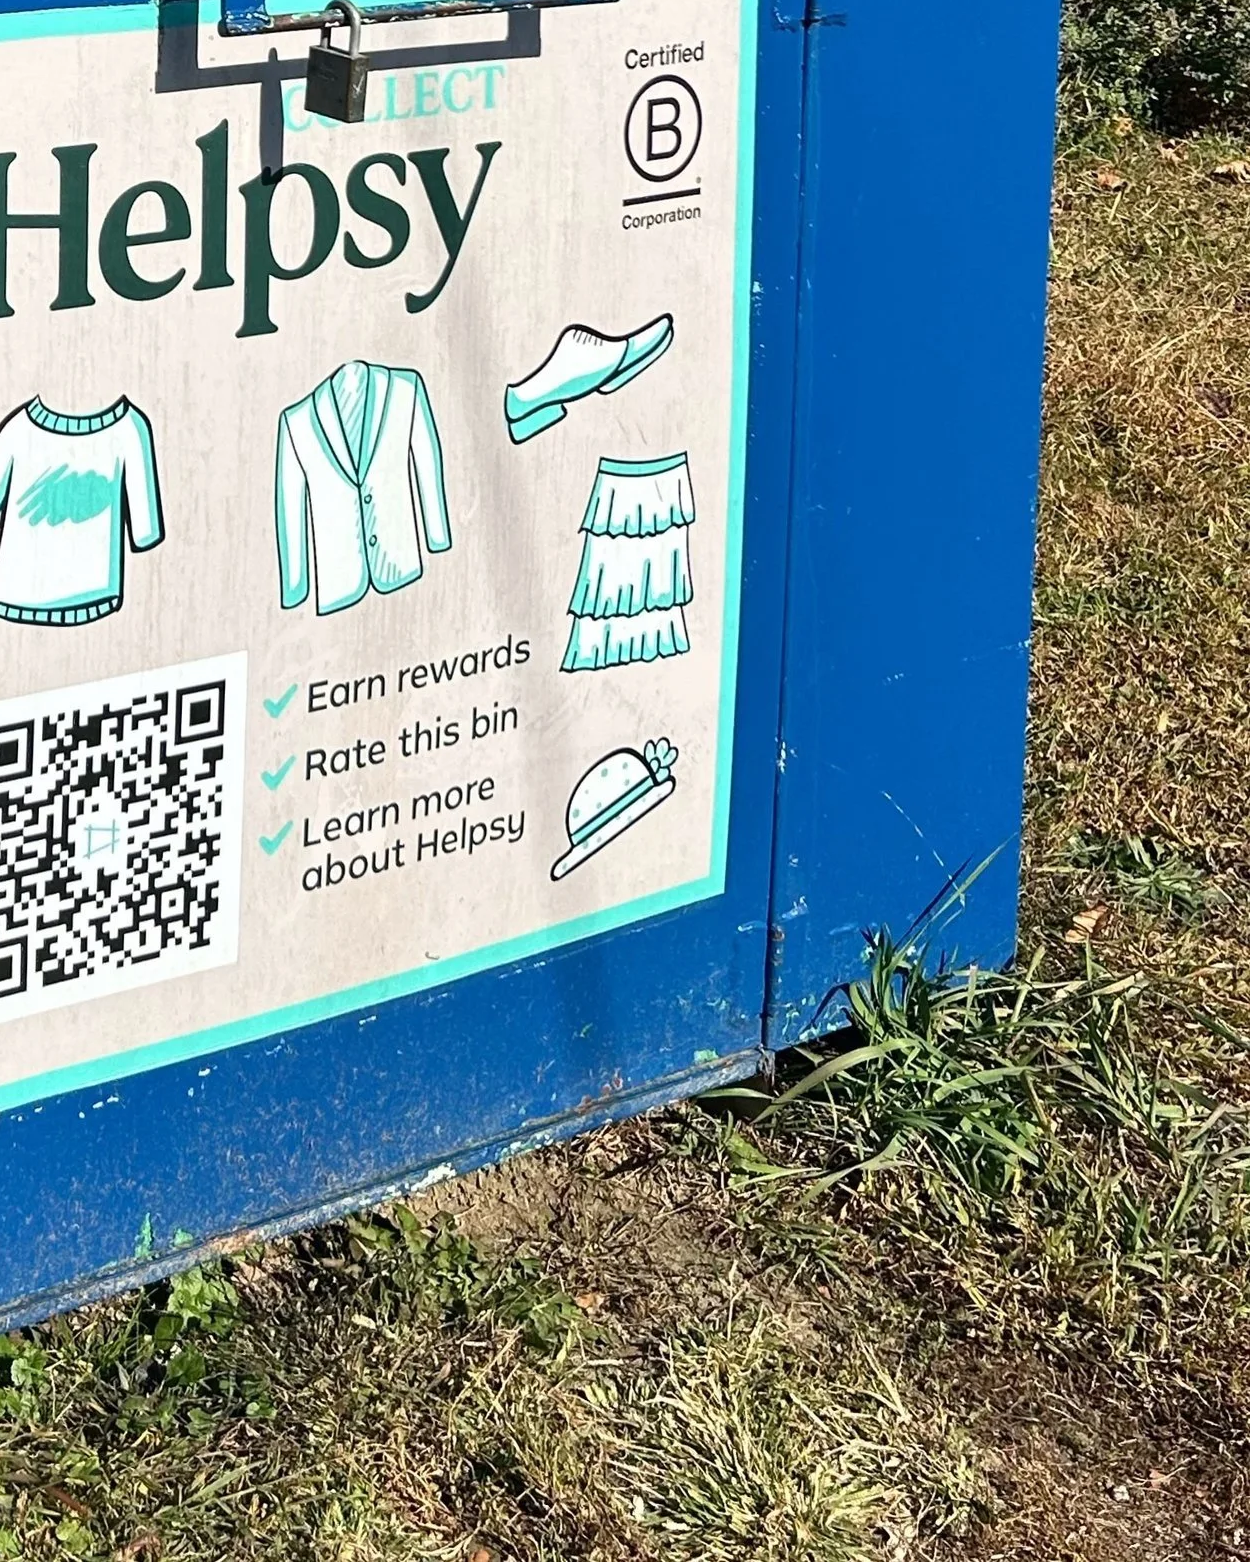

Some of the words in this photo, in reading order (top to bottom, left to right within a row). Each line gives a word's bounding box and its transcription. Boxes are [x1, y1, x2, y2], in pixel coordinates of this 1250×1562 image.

[624, 40, 706, 70] Certified
[621, 205, 702, 231] Corporation
[307, 672, 386, 713] Earn
[397, 634, 531, 692] rewards
[305, 739, 386, 780] Rate
[398, 716, 460, 758] this
[471, 701, 518, 740] bin
[303, 801, 400, 847] Learn
[411, 777, 495, 820] more
[302, 839, 406, 891] about
[416, 810, 526, 863] Helpsy
